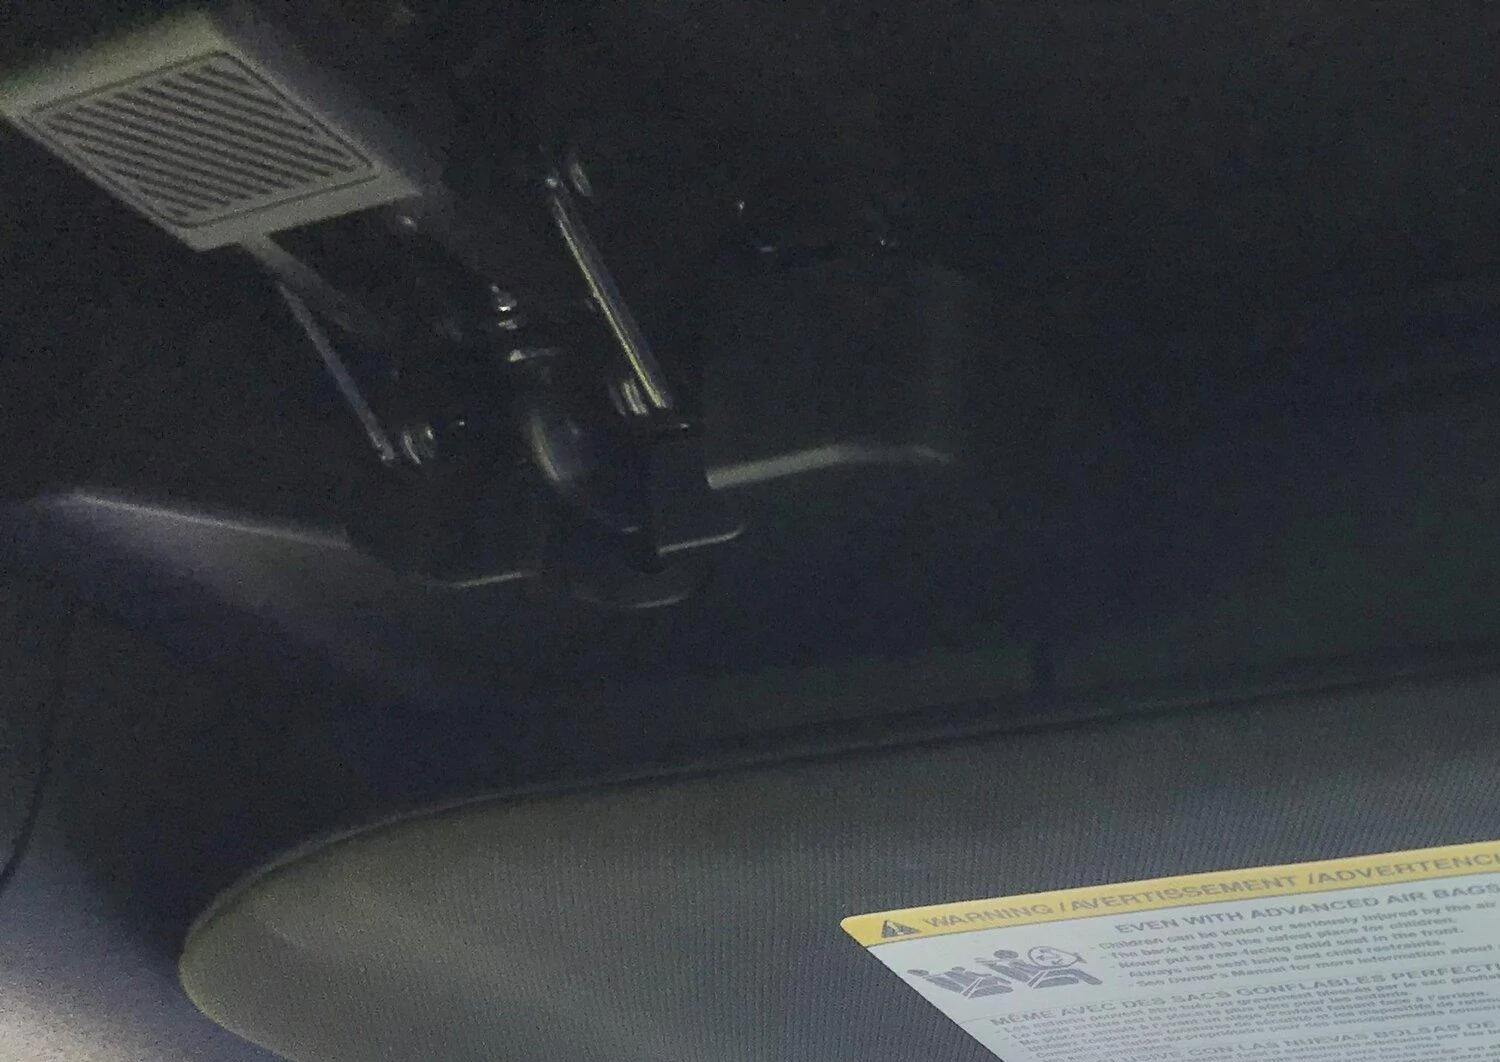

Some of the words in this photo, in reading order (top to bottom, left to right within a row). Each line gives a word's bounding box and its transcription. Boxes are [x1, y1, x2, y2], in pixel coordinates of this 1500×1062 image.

[923, 904, 1053, 926] WARNING
[1115, 918, 1177, 932] EVEN
[1182, 911, 1243, 925] WITH
[1247, 896, 1380, 918] ADVANCED
[1383, 891, 1426, 904] AIR
[988, 1009, 1057, 1024] MÊME
[1057, 1003, 1118, 1015] AVEC
[1120, 997, 1167, 1008] DES
[1170, 990, 1230, 1002] SACS
[1235, 975, 1386, 996] GONFLABLES
[1374, 1024, 1461, 1038] BOLSAS
[1466, 1021, 1494, 1029] DE
